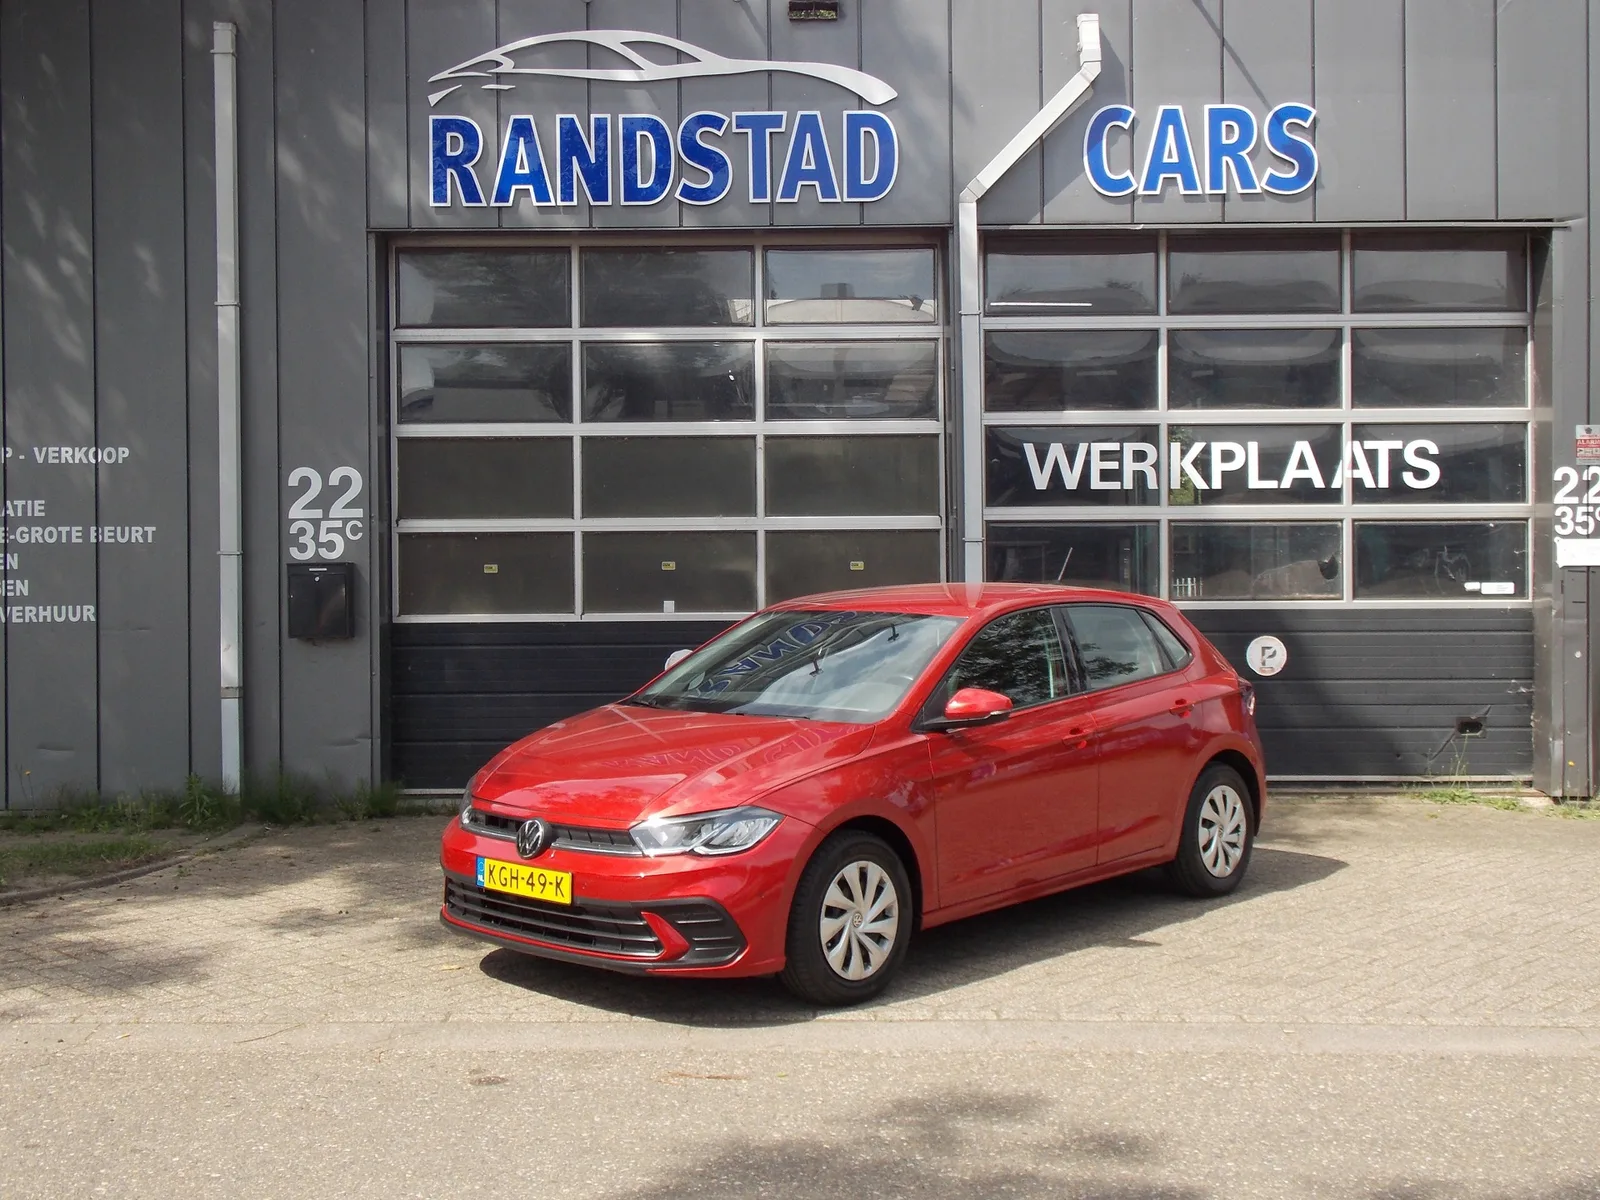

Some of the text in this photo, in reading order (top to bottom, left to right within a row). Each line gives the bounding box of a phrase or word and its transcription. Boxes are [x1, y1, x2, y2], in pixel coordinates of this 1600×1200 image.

[428, 102, 1319, 207] RANDSTAD CARS
[33, 447, 130, 464] VERKOOP
[1023, 439, 1441, 490] WERKPLAATS
[288, 466, 364, 519] 22
[1553, 466, 1600, 504] 22
[0, 500, 46, 517] ATIE
[90, 526, 156, 544] BEURT
[0, 579, 29, 597] EN
[487, 863, 565, 898] KGH-49-K
